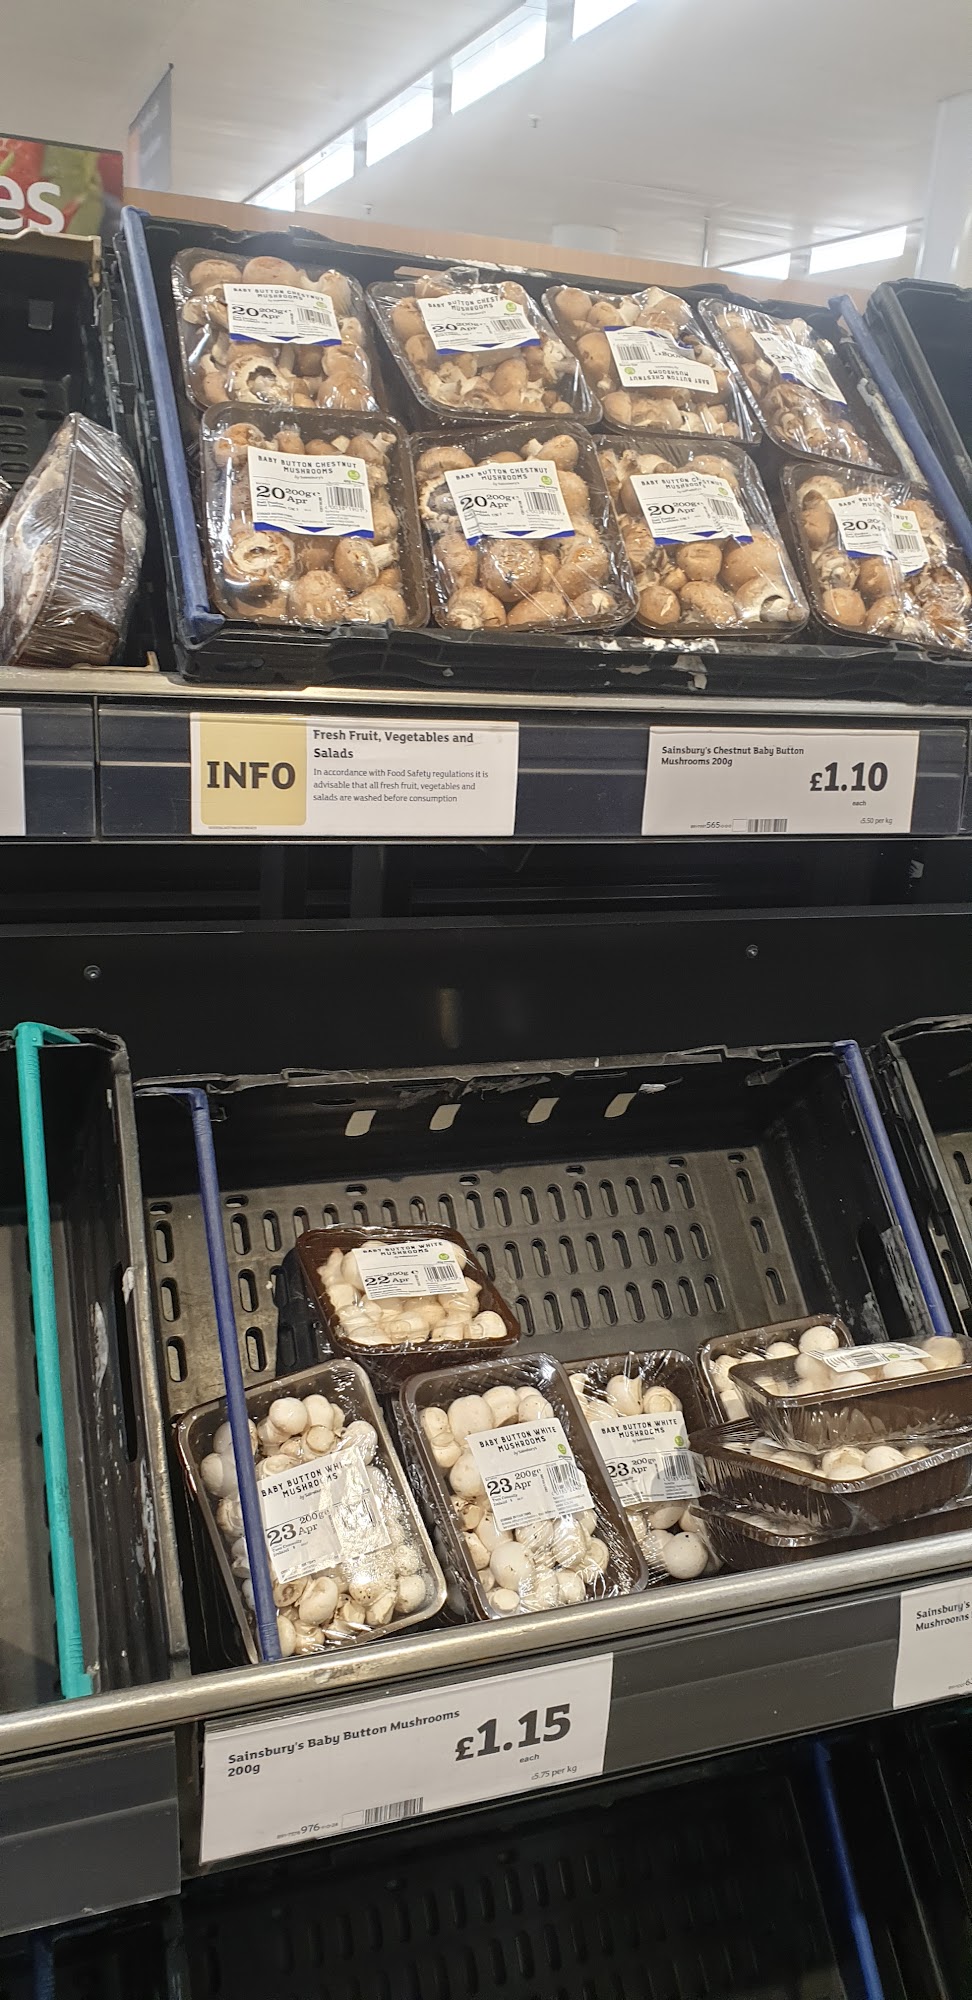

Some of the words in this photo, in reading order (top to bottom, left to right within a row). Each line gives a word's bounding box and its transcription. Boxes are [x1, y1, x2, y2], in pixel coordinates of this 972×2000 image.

[287, 290, 324, 301] CHESTNUT
[476, 295, 499, 304] CHEST
[231, 306, 259, 316] 20
[452, 304, 494, 312] MUSHROOMS
[432, 323, 458, 333] 20
[666, 375, 692, 383] BUTTON
[257, 455, 277, 464] BABY
[280, 460, 312, 468] BUTTON
[477, 468, 507, 476] BUTTON
[256, 485, 285, 499] 20
[285, 488, 312, 498] 200g
[286, 496, 308, 504] Apr
[460, 496, 487, 511] 20
[486, 494, 511, 502] 200g
[648, 504, 674, 516] 20
[842, 520, 868, 531] 20
[313, 729, 346, 740] Fresh
[349, 730, 381, 742] Fruit,
[384, 732, 449, 744] Vegetables
[452, 733, 474, 743] and
[314, 748, 354, 758] Salads
[662, 746, 711, 756] Sainsbury's
[714, 747, 751, 755] Chestnut
[753, 747, 774, 756] Baby
[776, 747, 804, 755] Button
[661, 757, 710, 765] Mushrooms
[712, 758, 733, 767] 200g
[207, 761, 296, 790] INFO
[314, 768, 322, 776] In
[407, 770, 431, 779] Safety
[432, 770, 474, 780] regulations
[810, 762, 888, 791] £1.10
[313, 781, 350, 789] advisable
[352, 781, 367, 789] that
[401, 782, 419, 790] fruit,
[420, 783, 460, 791] vegetables
[384, 794, 407, 802] before
[409, 795, 457, 803] consumption
[380, 1248, 429, 1256] MUSHROOMS
[365, 1276, 390, 1286] 22
[601, 1426, 620, 1434] BABY
[622, 1421, 652, 1430] BUTTON
[619, 1427, 665, 1438] MUSHROOMS
[479, 1438, 498, 1448] BABY
[501, 1430, 531, 1443] BUTTON
[533, 1426, 557, 1436] WHITE
[498, 1436, 546, 1452] MUSHROOMS
[606, 1463, 629, 1478] 23
[631, 1466, 647, 1474] Apr
[261, 1483, 283, 1497] BABY
[287, 1469, 322, 1486] BUTTON
[282, 1473, 338, 1498] MUSHROMS
[487, 1478, 512, 1496] 23
[514, 1480, 532, 1491] Apr
[267, 1524, 296, 1546] 23
[298, 1523, 318, 1536] Apr
[916, 1601, 970, 1620] Sainsbury's
[916, 1613, 969, 1632] Mushrooms
[228, 1742, 304, 1764] Sainsbury's
[308, 1735, 340, 1748] Baby
[343, 1725, 387, 1741] Button
[390, 1710, 460, 1731] Mushrooms
[455, 1703, 571, 1761] £1.15
[520, 1754, 539, 1763] each
[227, 1764, 261, 1777] 200g
[552, 1768, 565, 1778] per
[300, 1824, 320, 1834] 976
